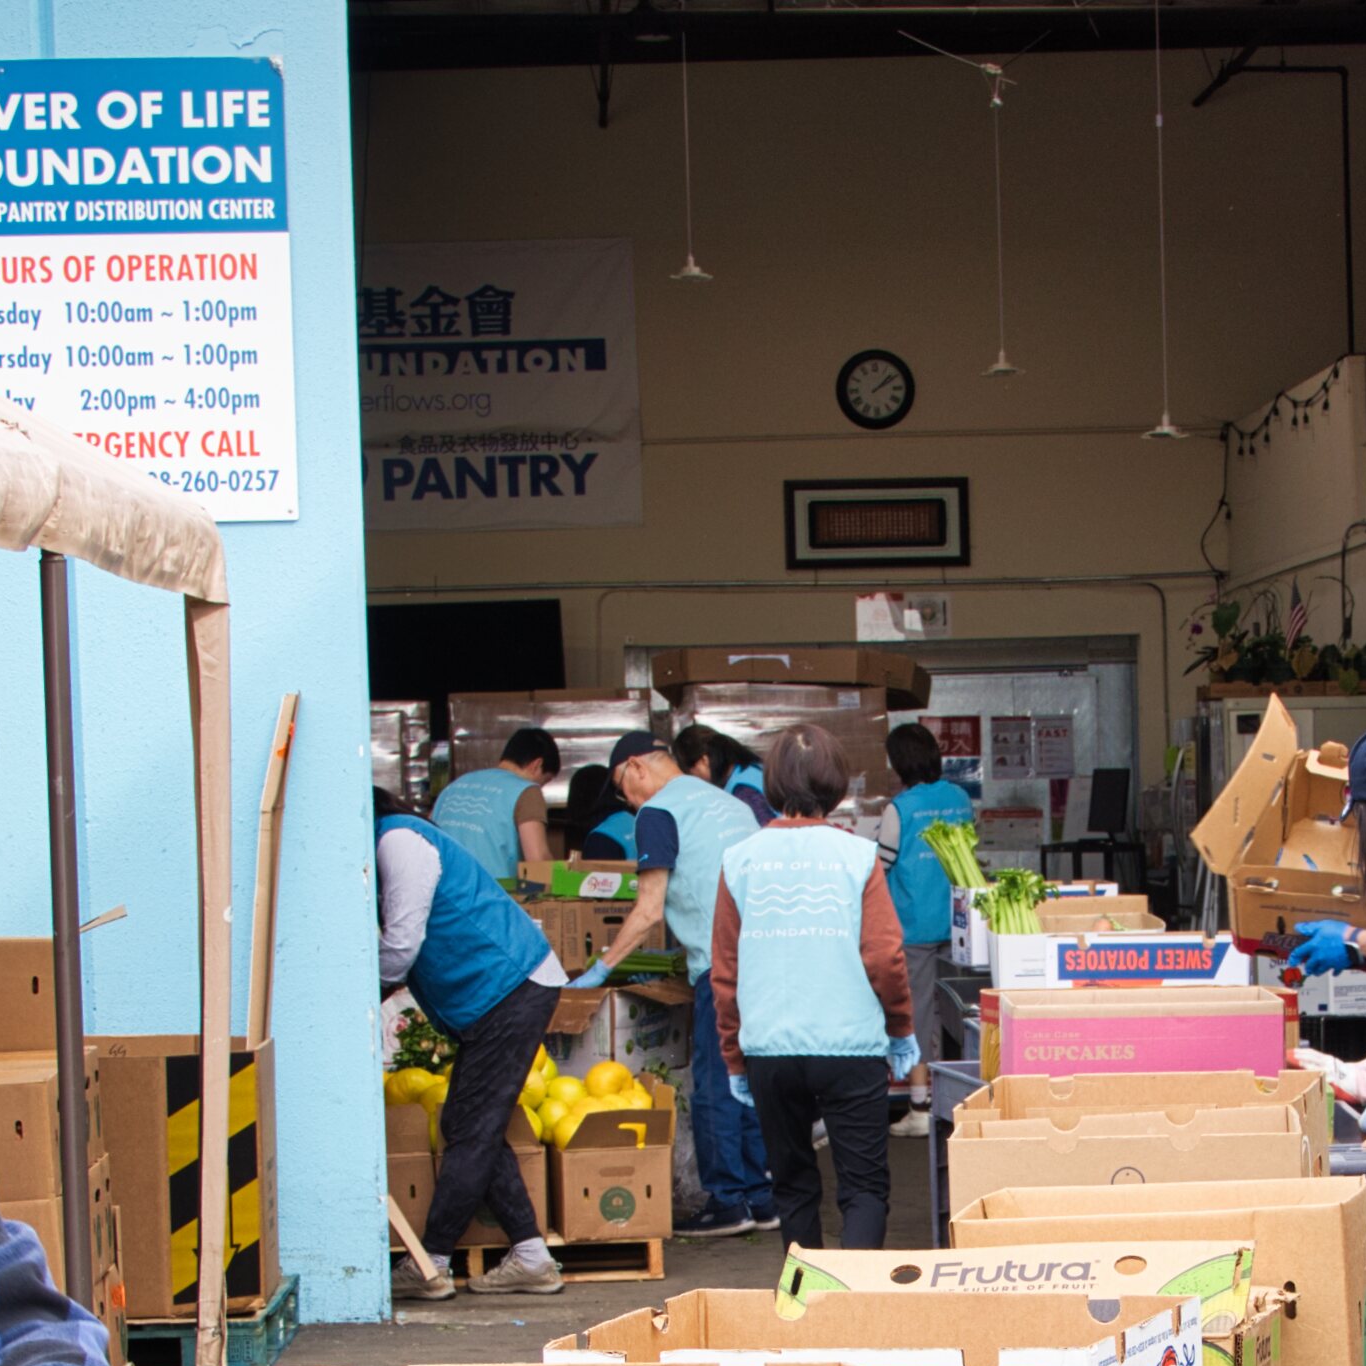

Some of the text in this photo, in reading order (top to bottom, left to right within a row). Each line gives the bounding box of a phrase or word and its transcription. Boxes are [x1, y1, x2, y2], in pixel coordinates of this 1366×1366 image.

[97, 90, 163, 130] OF
[181, 90, 271, 129] LIFE
[76, 199, 203, 221] DISTRIBUTION
[208, 198, 276, 220] CENTER
[63, 255, 96, 283] OF
[106, 253, 259, 282] OPERATION
[65, 300, 153, 325] 10:00am
[183, 300, 258, 327] 1:00pm
[357, 284, 516, 338] 基金會
[65, 345, 154, 368] 10:00am
[183, 343, 259, 371] 1:00pm
[360, 346, 587, 377] UNDATION
[80, 389, 157, 417] 2:00pm
[183, 387, 260, 415] 4:00pm
[361, 384, 492, 418] erflows.org
[73, 429, 261, 459] RGENCY CALL
[148, 469, 280, 493] 8-260-0257
[382, 452, 598, 502] PANTRY
[790, 860, 813, 871] OF
[741, 926, 850, 939] FOUNDATION
[1064, 949, 1214, 972] SWEET POTATOES
[1023, 1043, 1136, 1063] CUPCAKES
